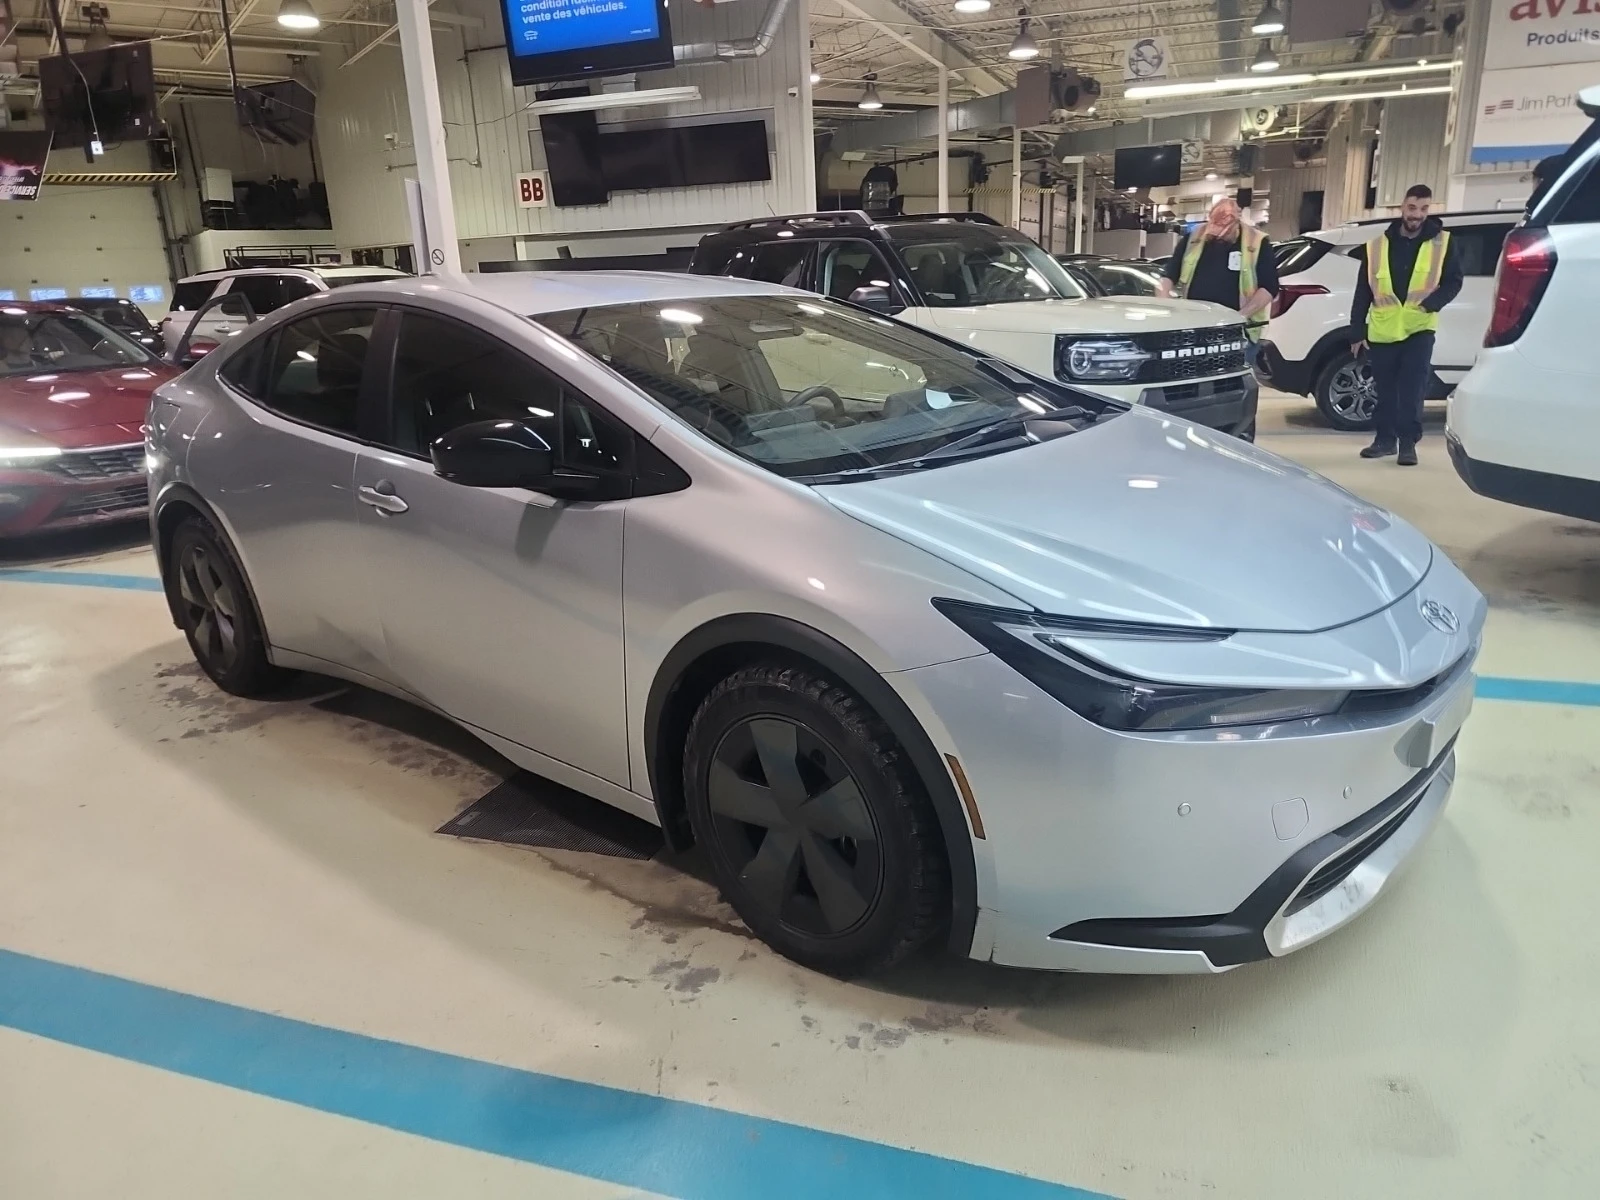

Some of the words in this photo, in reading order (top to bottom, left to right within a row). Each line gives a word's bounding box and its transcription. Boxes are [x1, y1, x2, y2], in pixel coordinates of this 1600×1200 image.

[521, 0, 569, 12] condition
[522, 12, 551, 24] vente
[552, 10, 572, 19] des
[573, 2, 627, 16] véhicules.
[1527, 28, 1600, 46] Produits
[1516, 96, 1543, 111] Jim
[1546, 94, 1577, 109] Pat
[520, 178, 544, 202] BB
[1161, 342, 1241, 359] BRONCO
